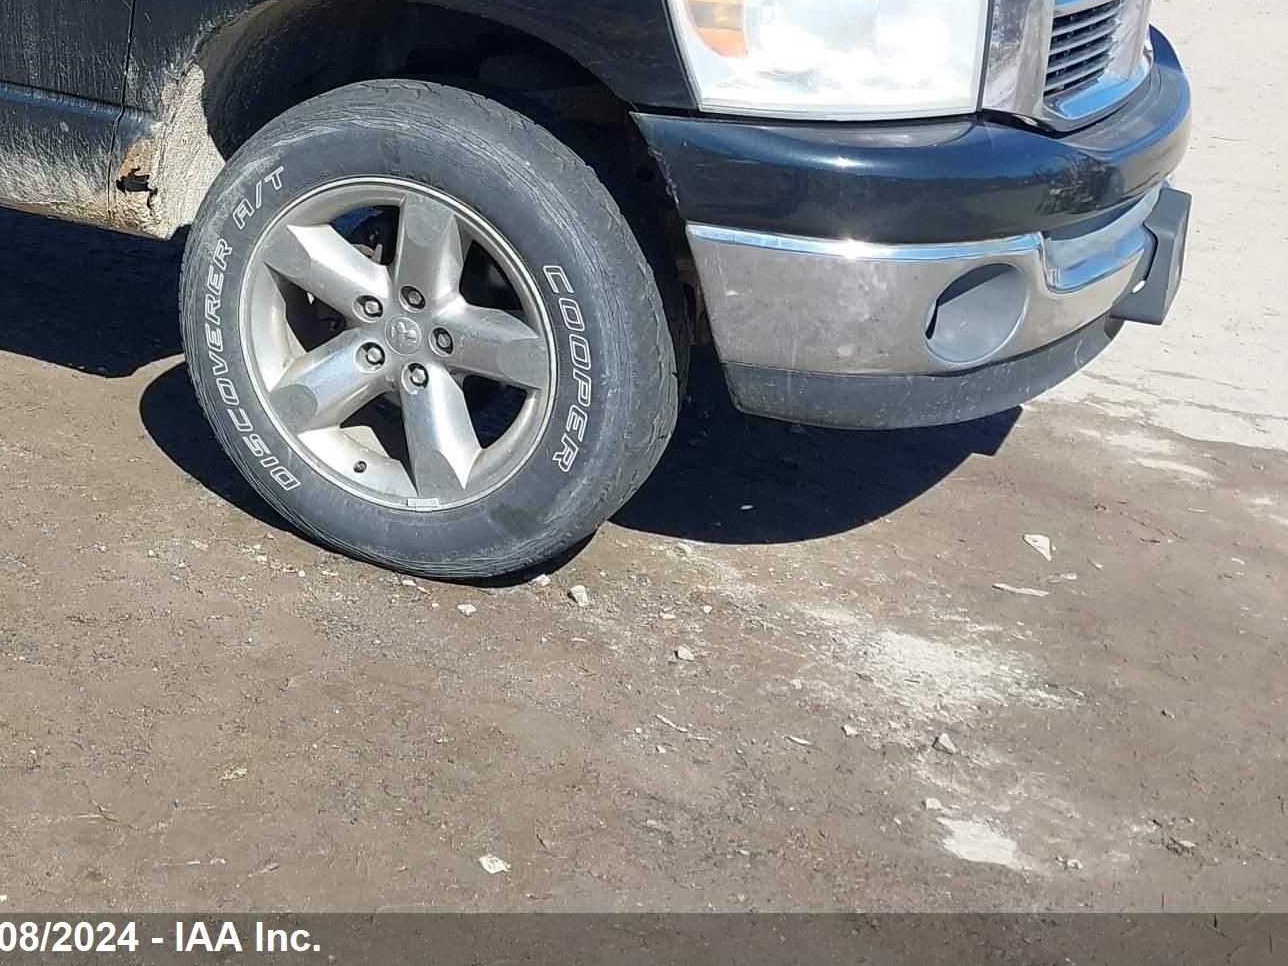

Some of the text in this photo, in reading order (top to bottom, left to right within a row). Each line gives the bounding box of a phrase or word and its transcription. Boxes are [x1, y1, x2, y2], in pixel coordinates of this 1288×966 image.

[204, 166, 301, 491] DISCOVERER A/T
[543, 265, 592, 472] COOPER
